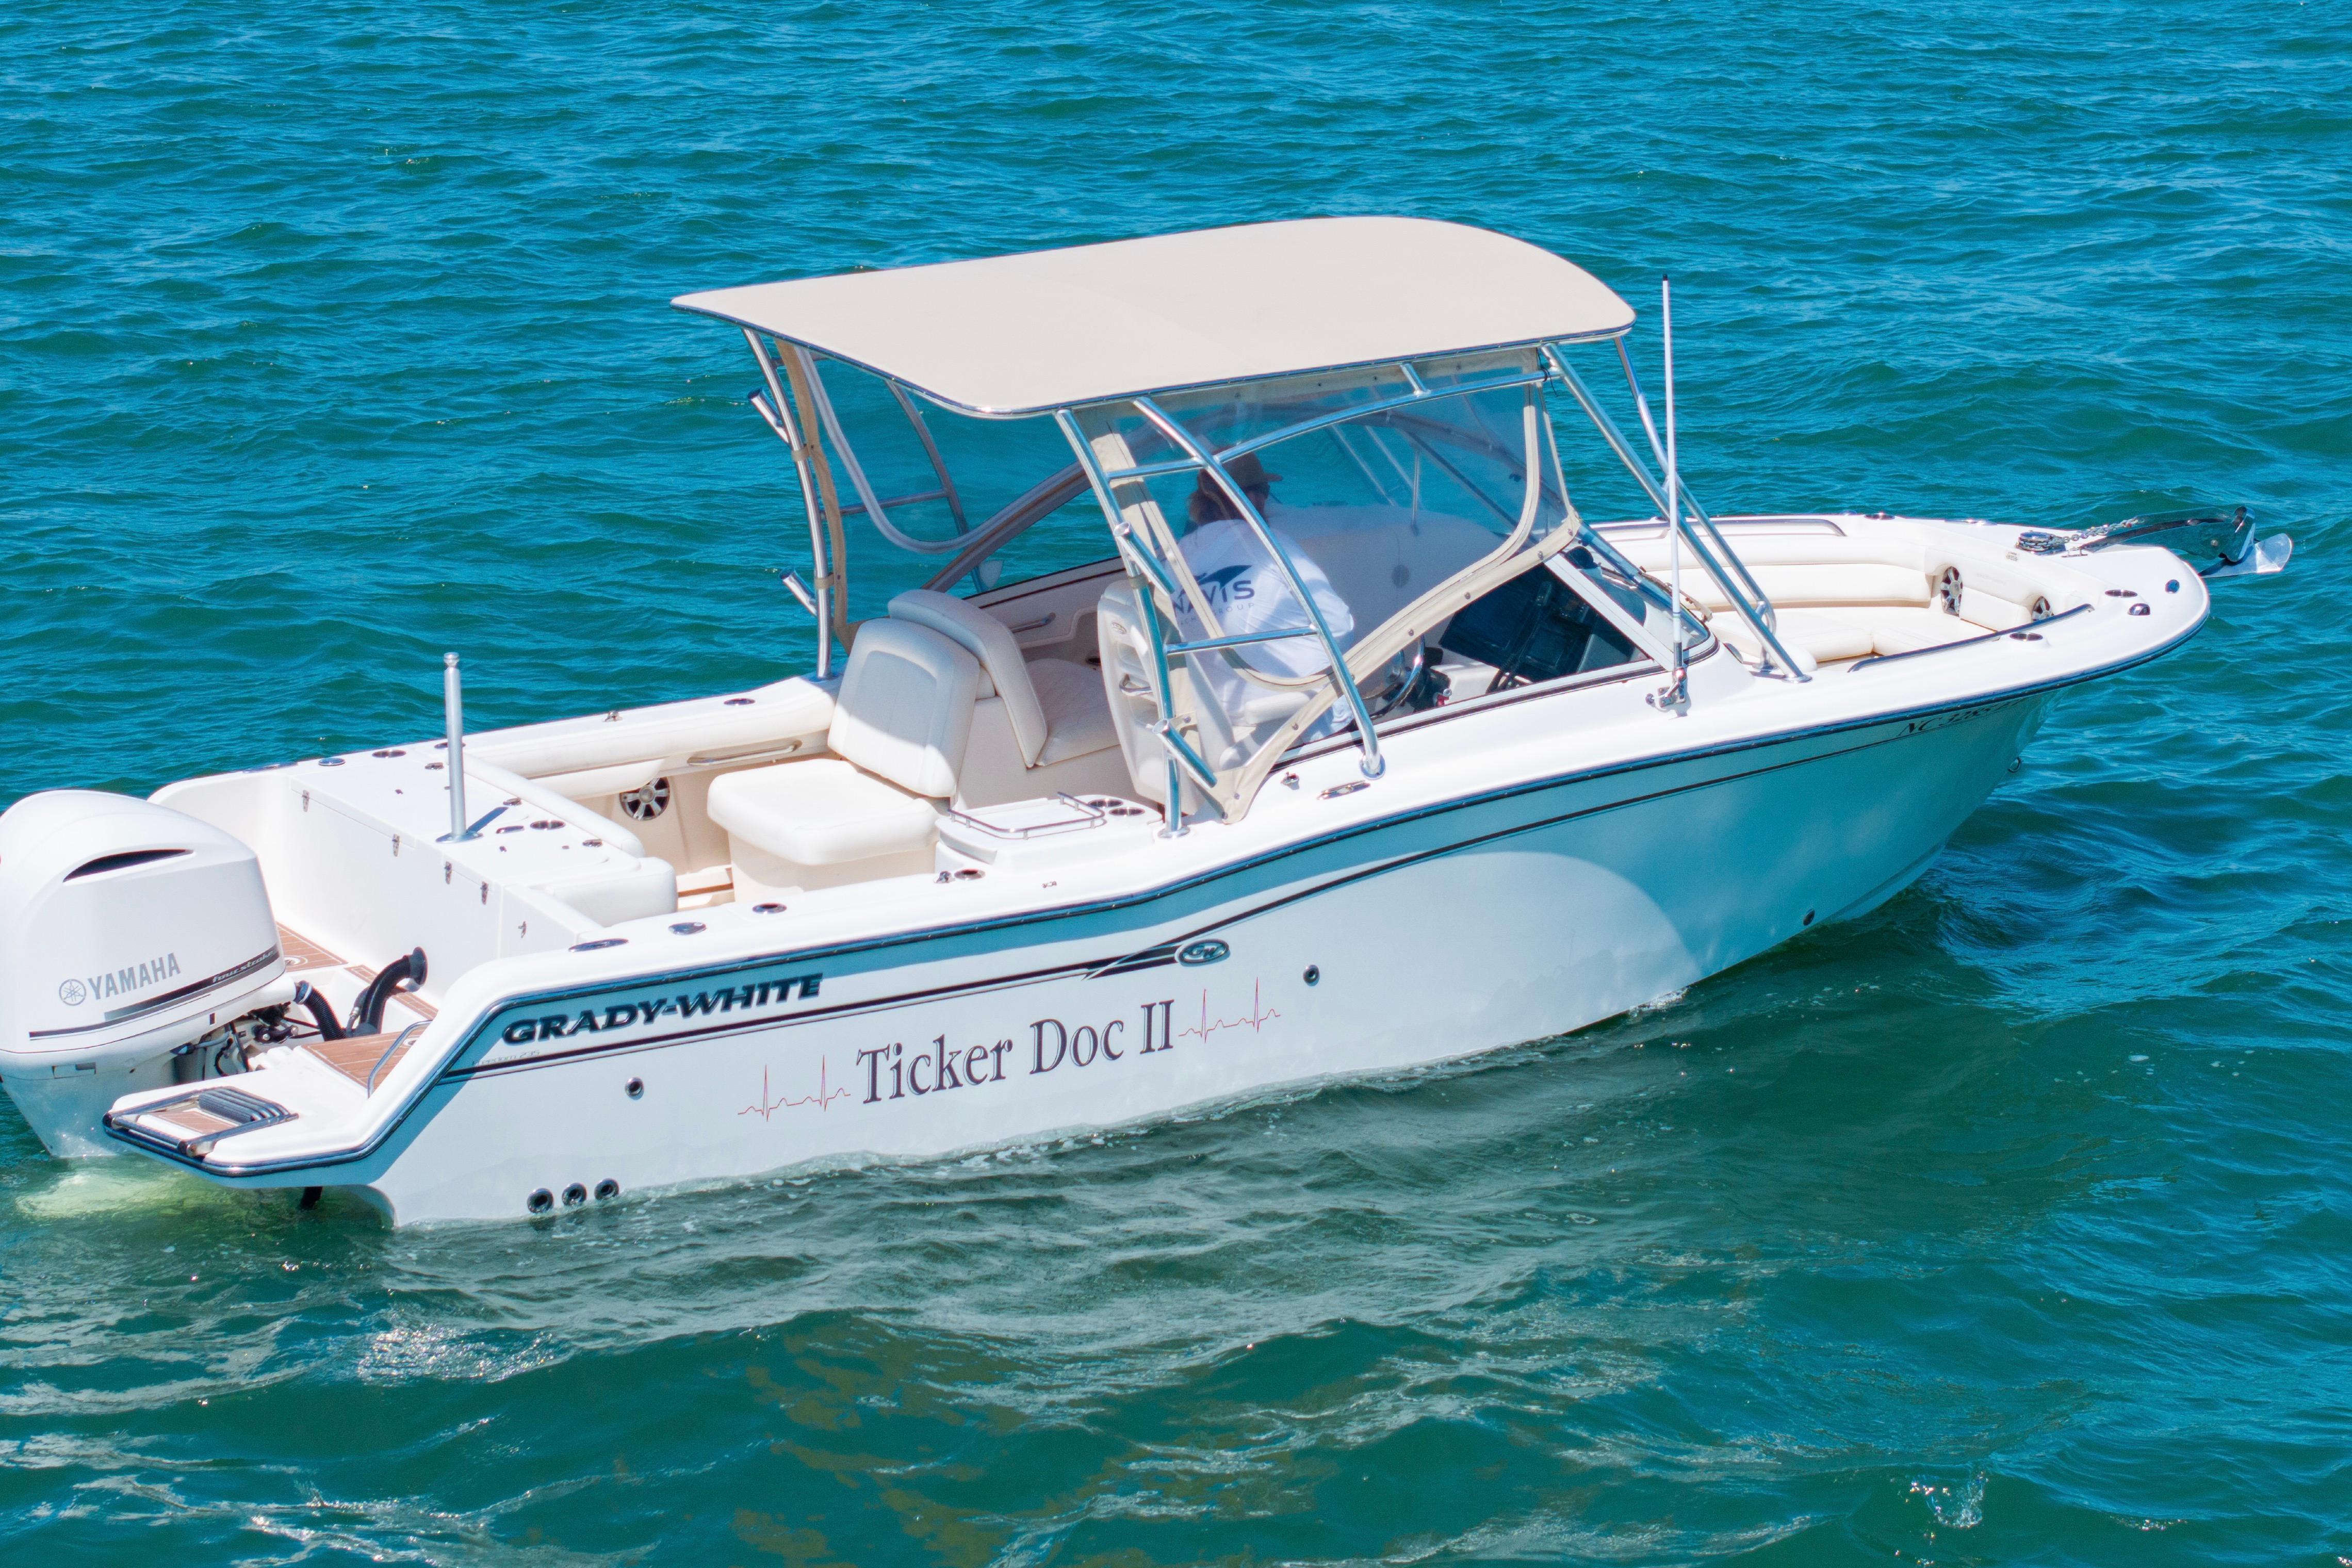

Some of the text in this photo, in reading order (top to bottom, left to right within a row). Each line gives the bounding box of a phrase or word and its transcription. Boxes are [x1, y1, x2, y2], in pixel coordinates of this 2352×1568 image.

[88, 952, 181, 1001] YAMAHA
[501, 973, 824, 1045] GRADY-WHITE
[857, 999, 1174, 1104] Ticker Doc II
